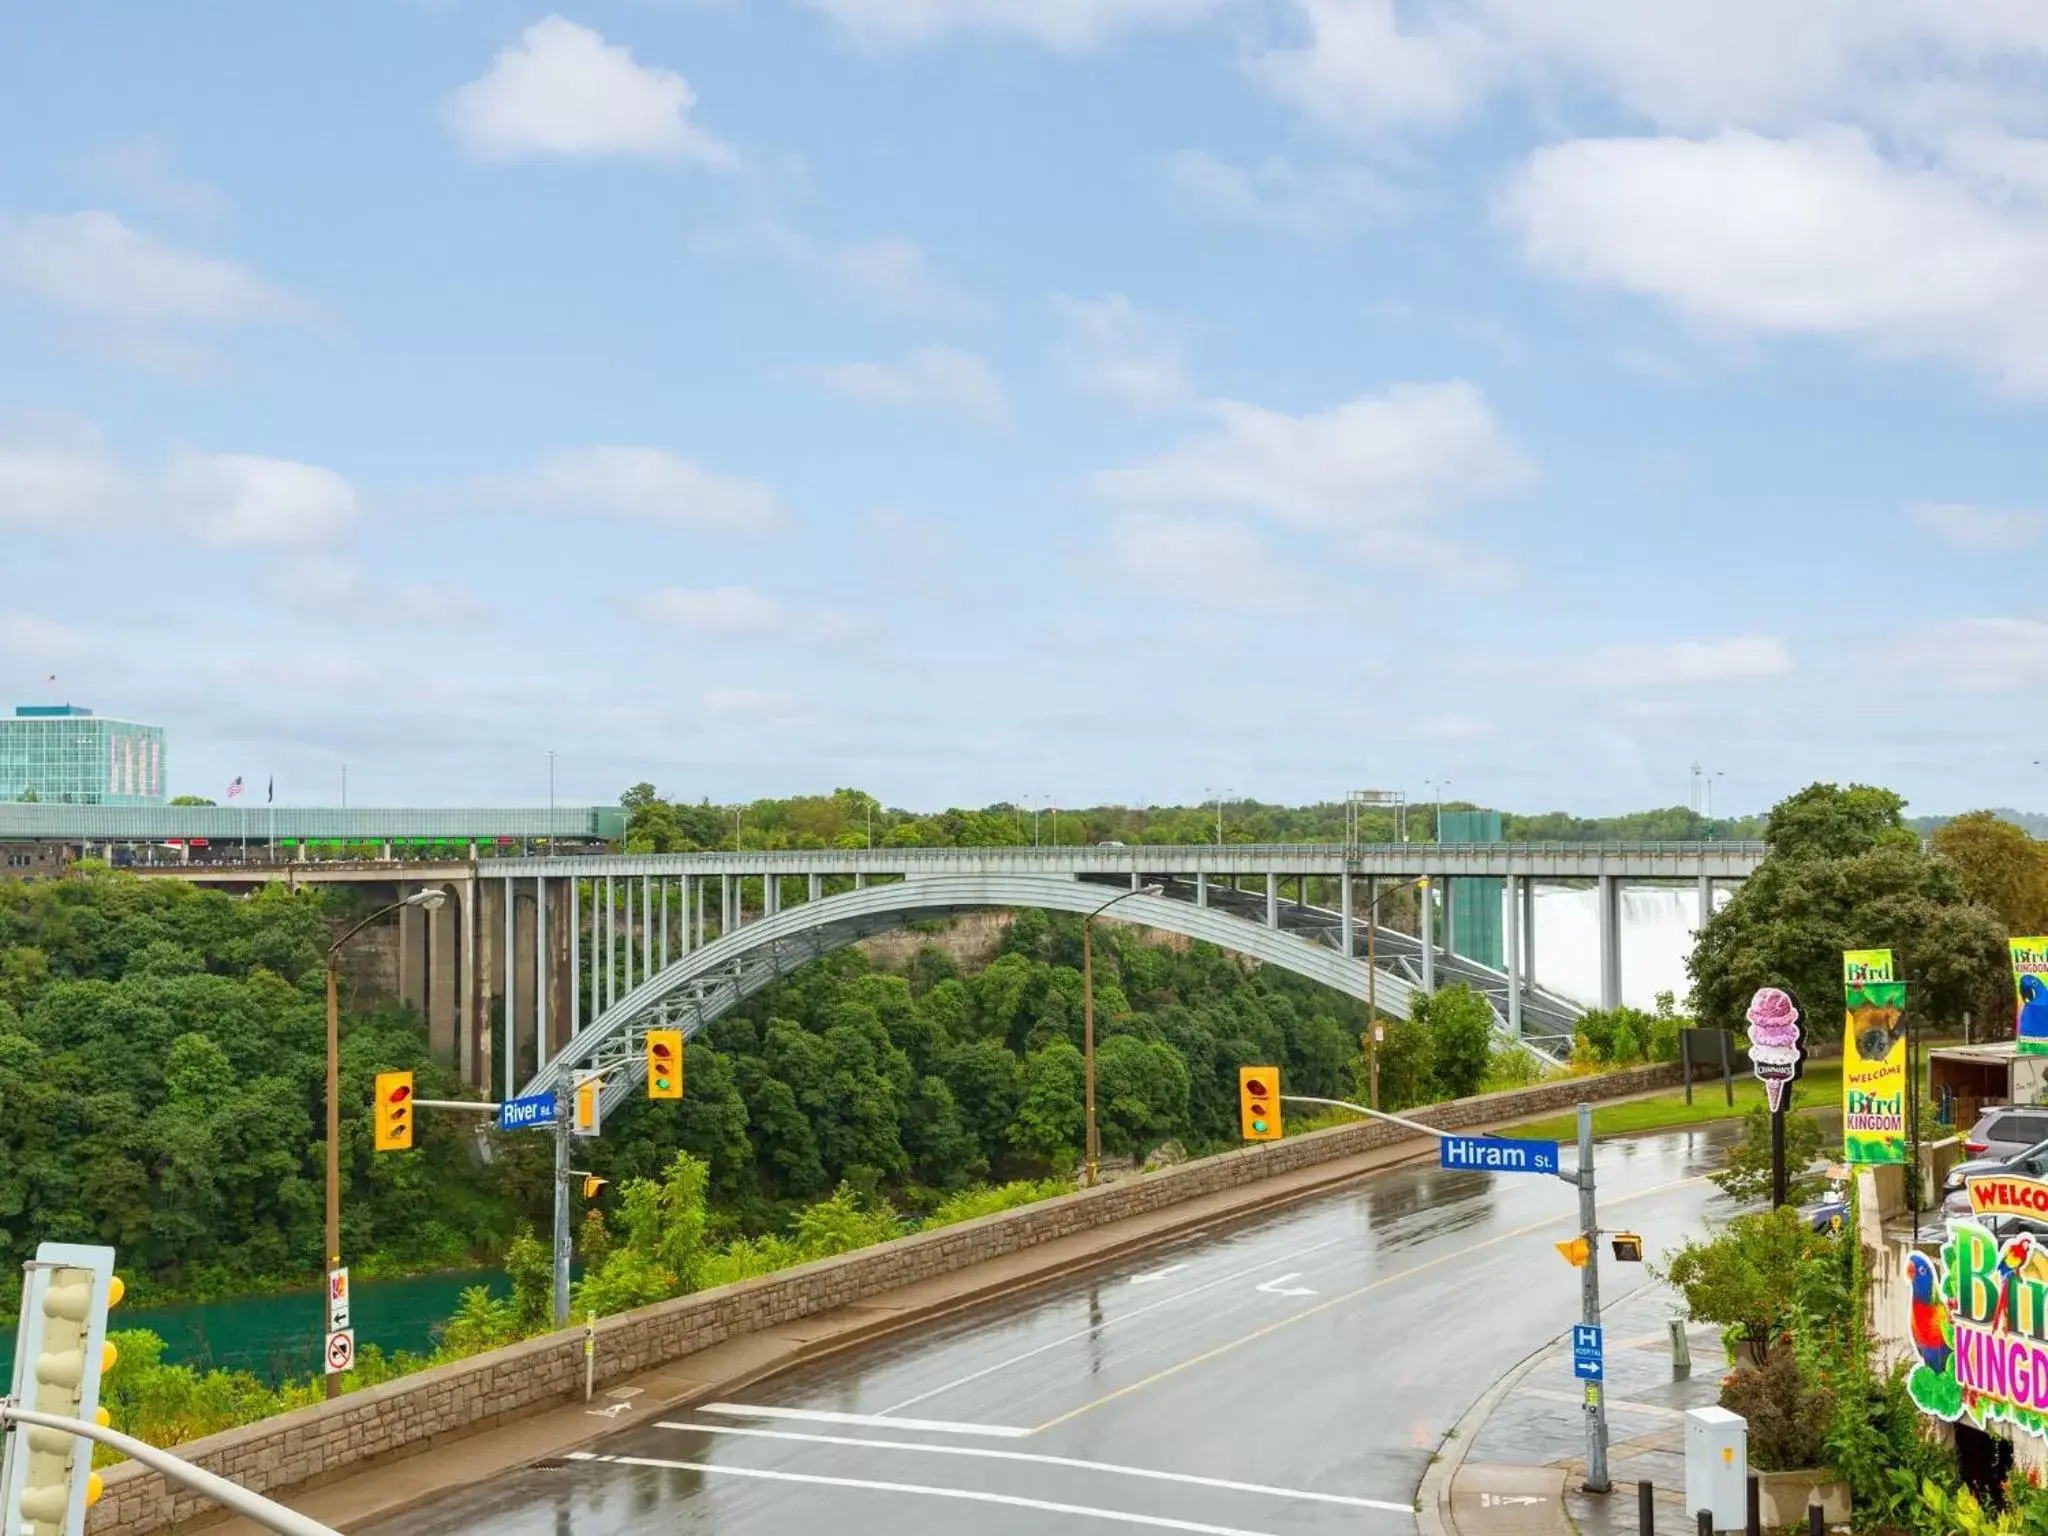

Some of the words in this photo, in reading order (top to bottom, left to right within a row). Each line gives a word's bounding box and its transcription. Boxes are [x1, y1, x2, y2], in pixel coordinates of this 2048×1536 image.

[1848, 1064, 1901, 1084] WELCOME
[504, 1102, 537, 1125] River
[1848, 1091, 1901, 1115] Bird
[1847, 1115, 1902, 1131] KINGDOM
[1448, 1140, 1526, 1166] Hiram
[1534, 1154, 1553, 1168] St.
[1579, 1328, 1597, 1347] H
